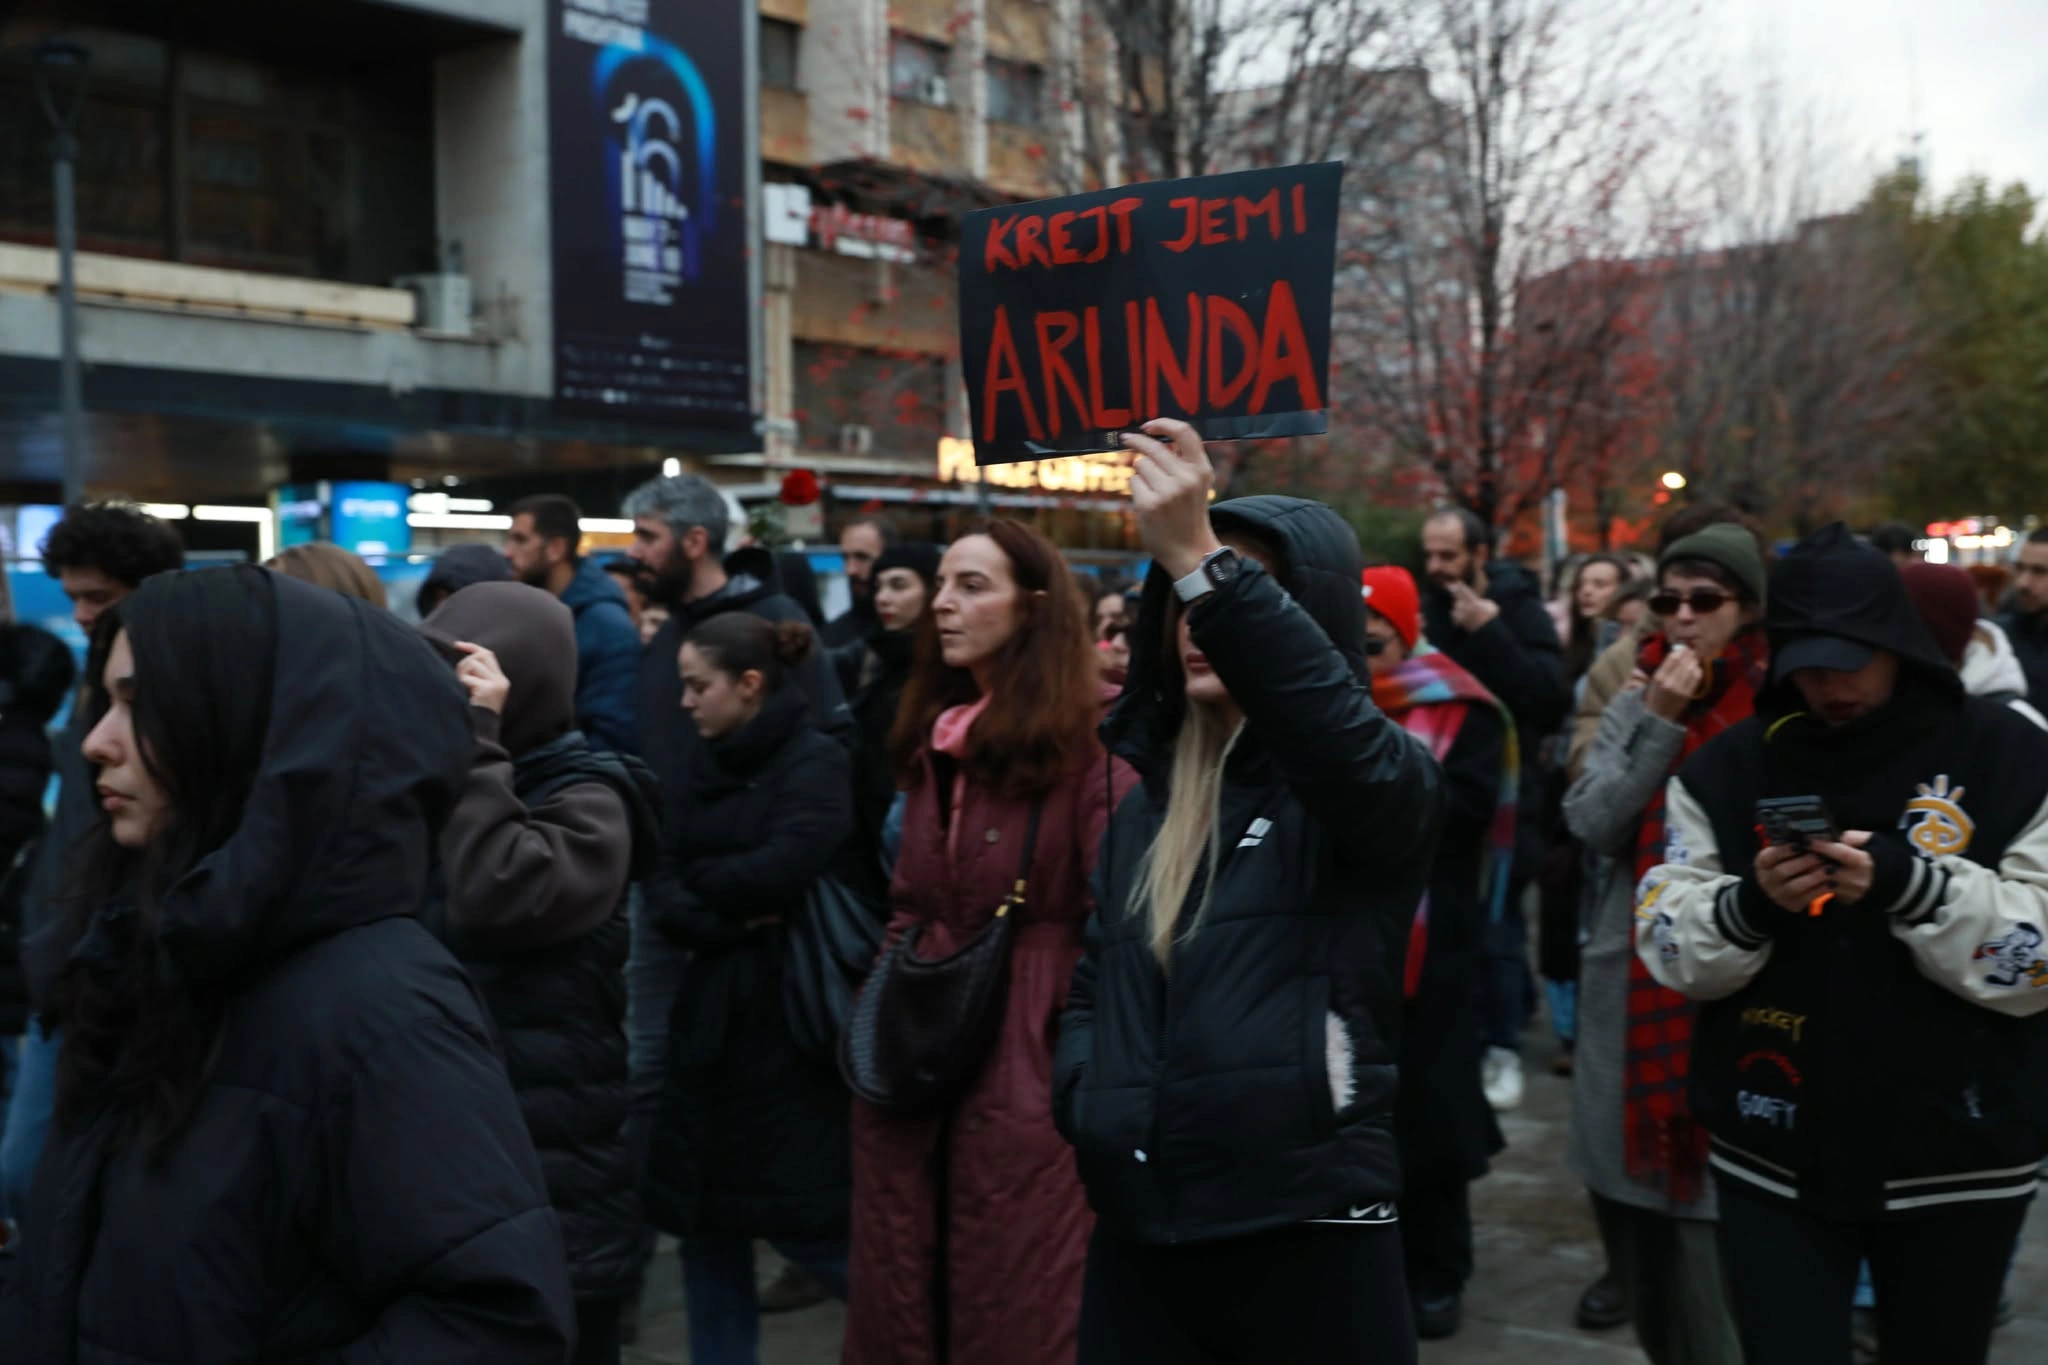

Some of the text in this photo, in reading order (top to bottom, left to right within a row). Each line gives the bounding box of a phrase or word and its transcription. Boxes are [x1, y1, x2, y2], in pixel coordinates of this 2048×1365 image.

[983, 197, 1144, 273] KREJT
[1158, 183, 1306, 253] JEMI
[983, 279, 1323, 442] ARLINDA
